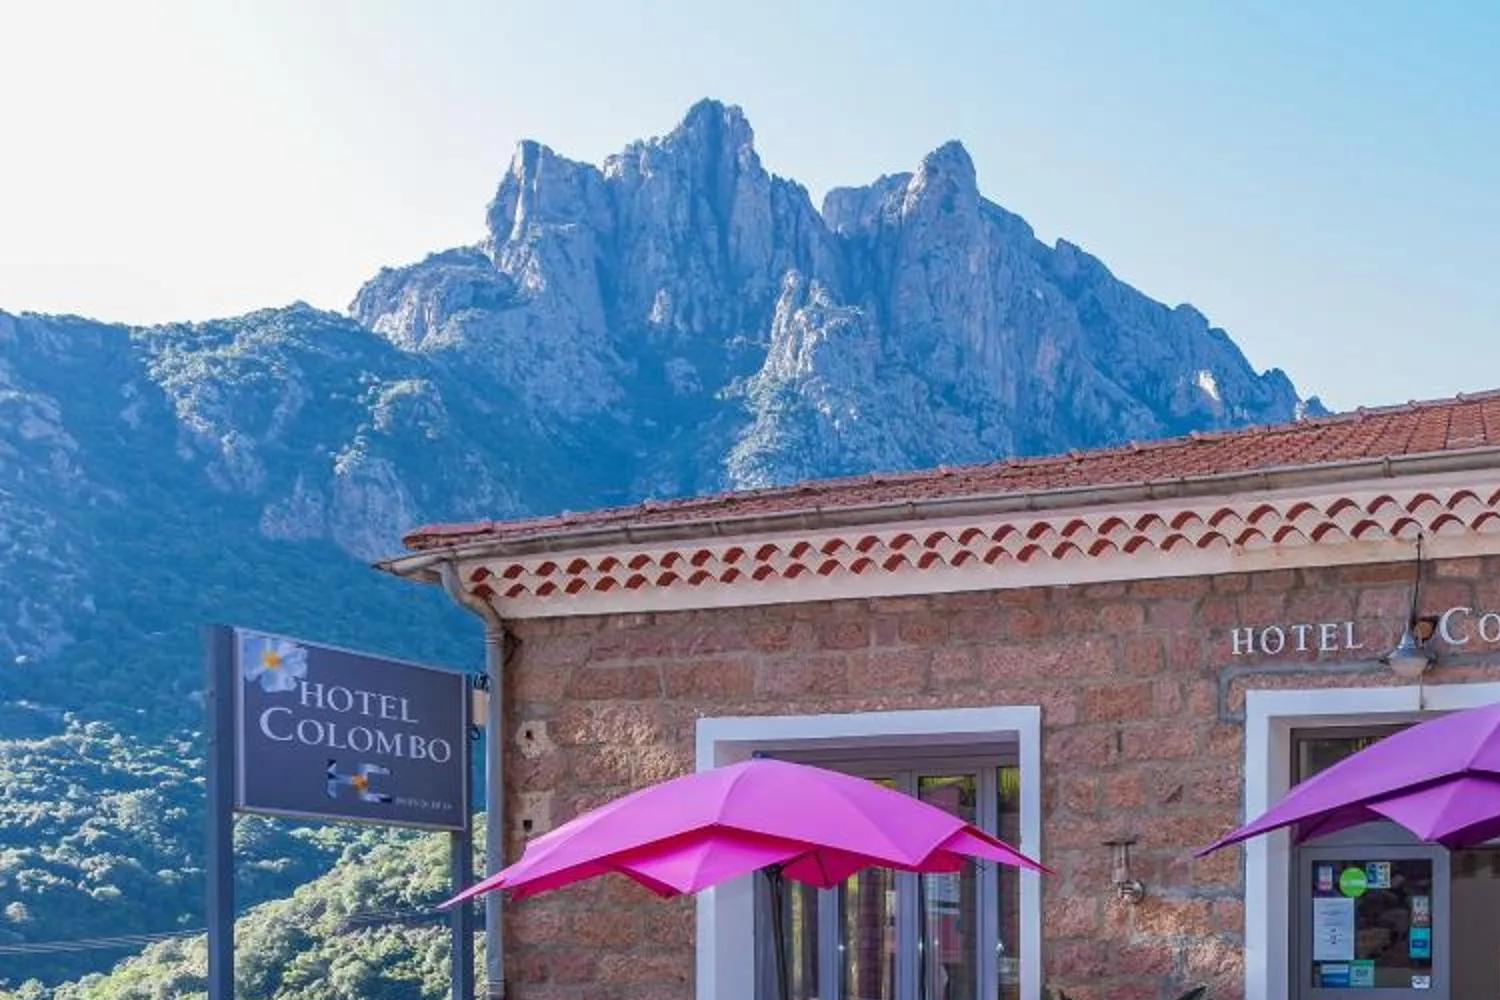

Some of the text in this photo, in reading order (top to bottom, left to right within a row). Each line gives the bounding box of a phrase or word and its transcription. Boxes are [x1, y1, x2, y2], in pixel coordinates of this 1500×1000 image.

[1231, 621, 1363, 655] HOTEL
[299, 680, 419, 724] HOTEL
[259, 706, 451, 763] COLOMBO
